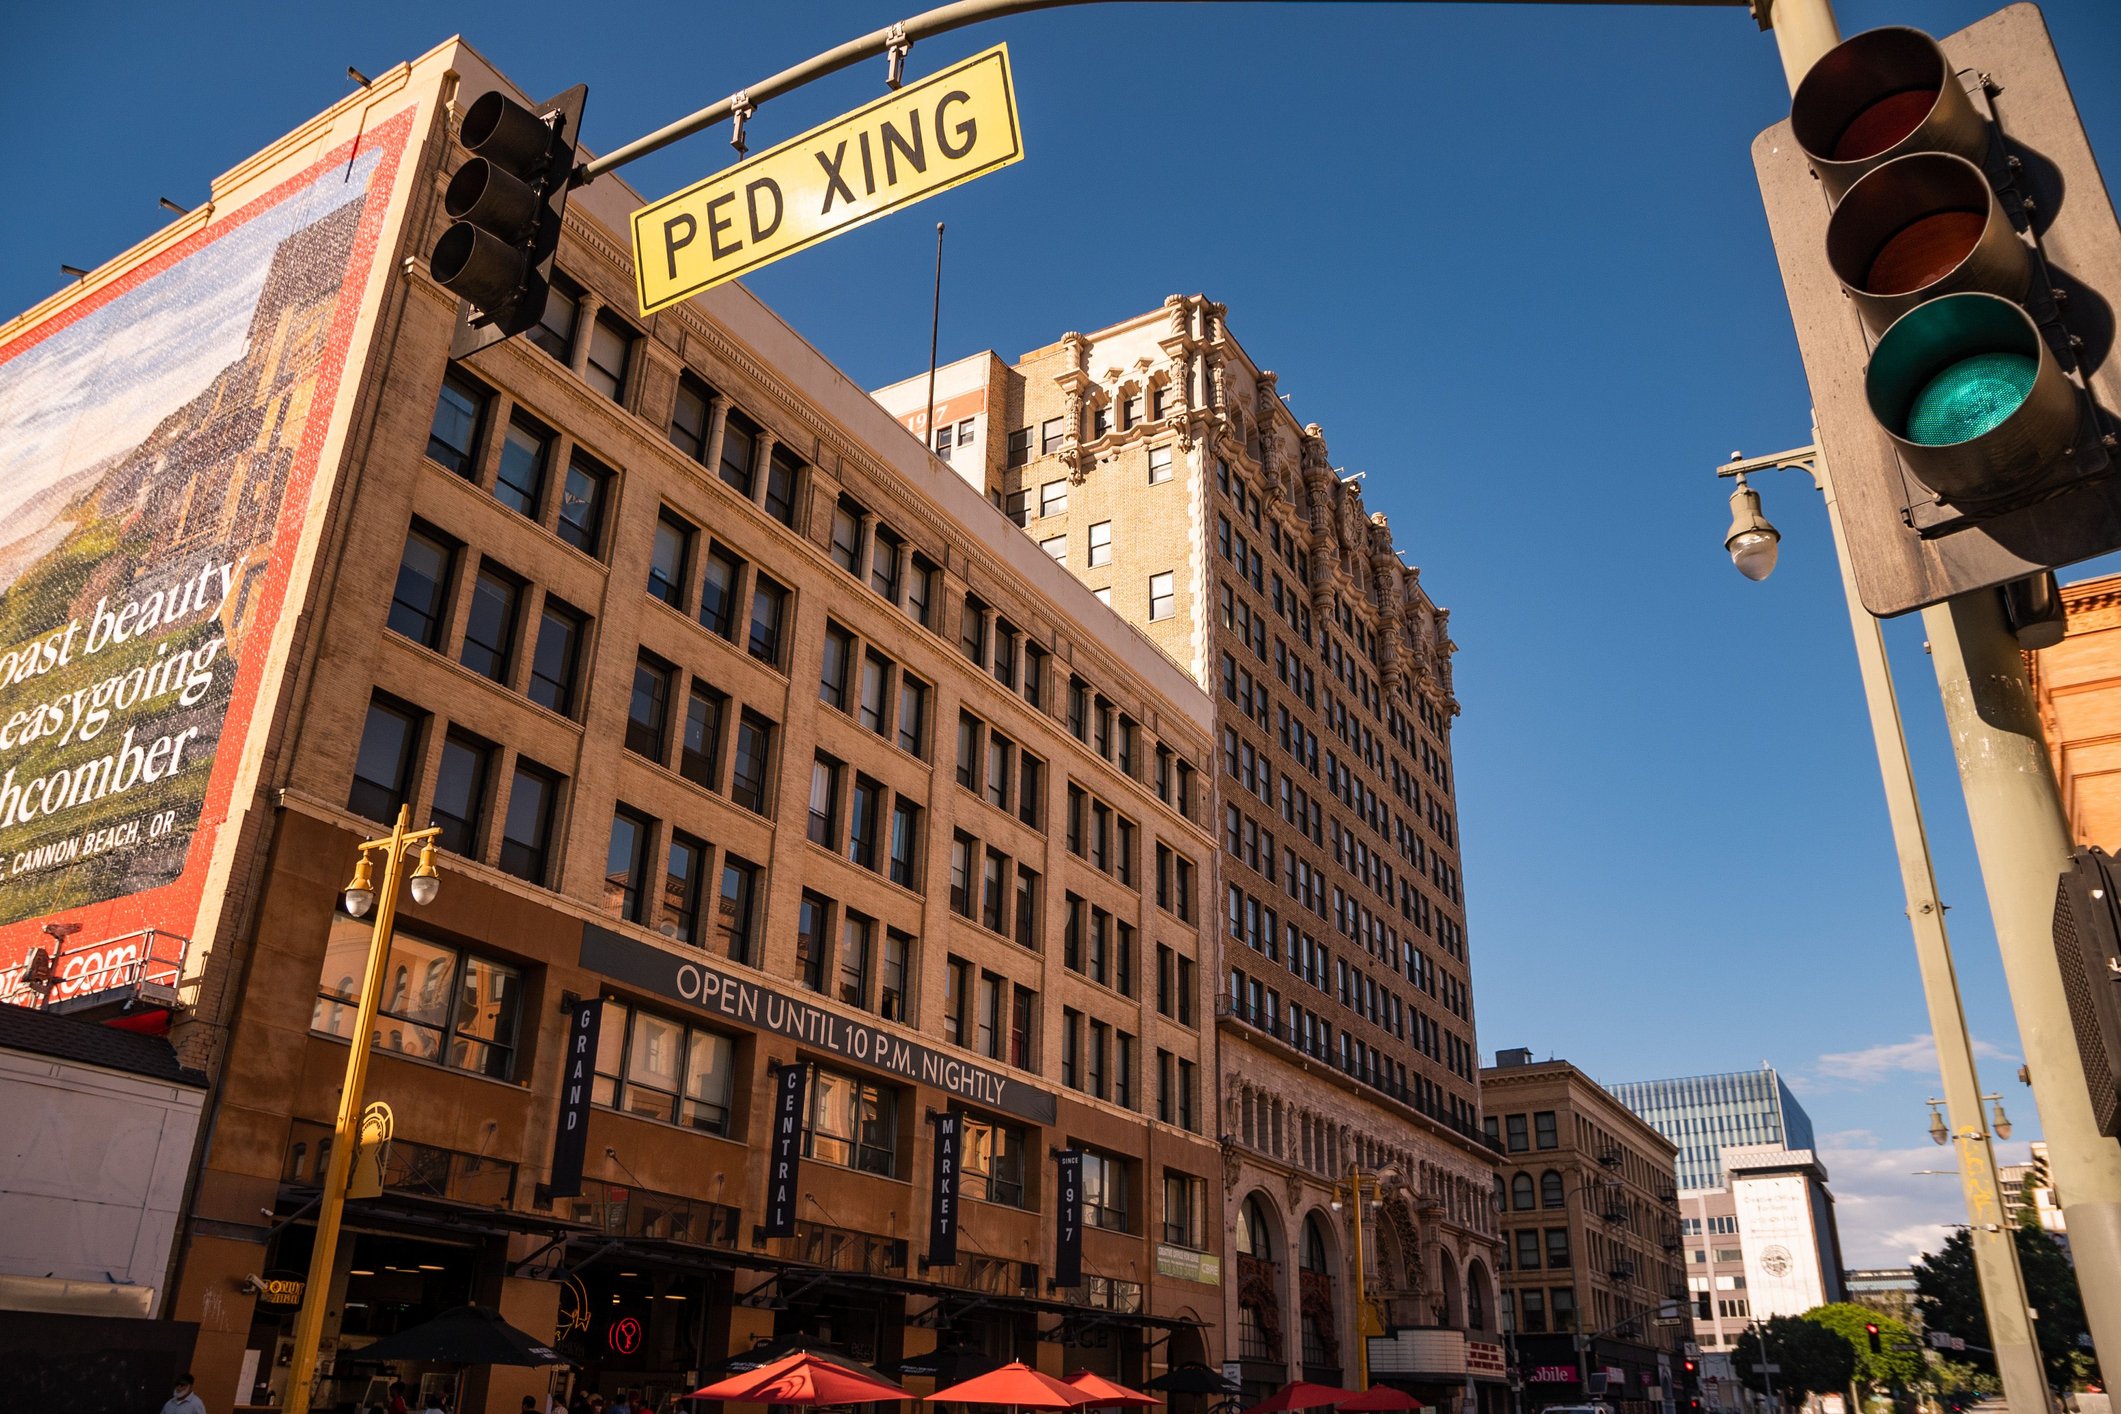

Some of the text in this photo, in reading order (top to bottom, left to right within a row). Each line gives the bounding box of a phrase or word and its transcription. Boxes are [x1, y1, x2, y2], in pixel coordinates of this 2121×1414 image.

[663, 89, 978, 281] PED XING
[907, 404, 949, 432] 197
[83, 554, 249, 656] beauty
[0, 637, 226, 748] easygoing
[12, 837, 81, 875] CANNON
[83, 819, 142, 856] BEACH,
[150, 809, 176, 838] OR
[567, 1008, 591, 1131] GRAND
[676, 964, 1007, 1105] OPEN UNTIL 10 P.M. NIGHTLY
[776, 1071, 797, 1226] CENTRAL
[940, 1118, 954, 1235] MARKET
[1061, 1156, 1079, 1165] SINCE
[1065, 1168, 1075, 1242] 1917
[1201, 1263, 1219, 1277] CBRE
[1529, 1365, 1569, 1382] obile
